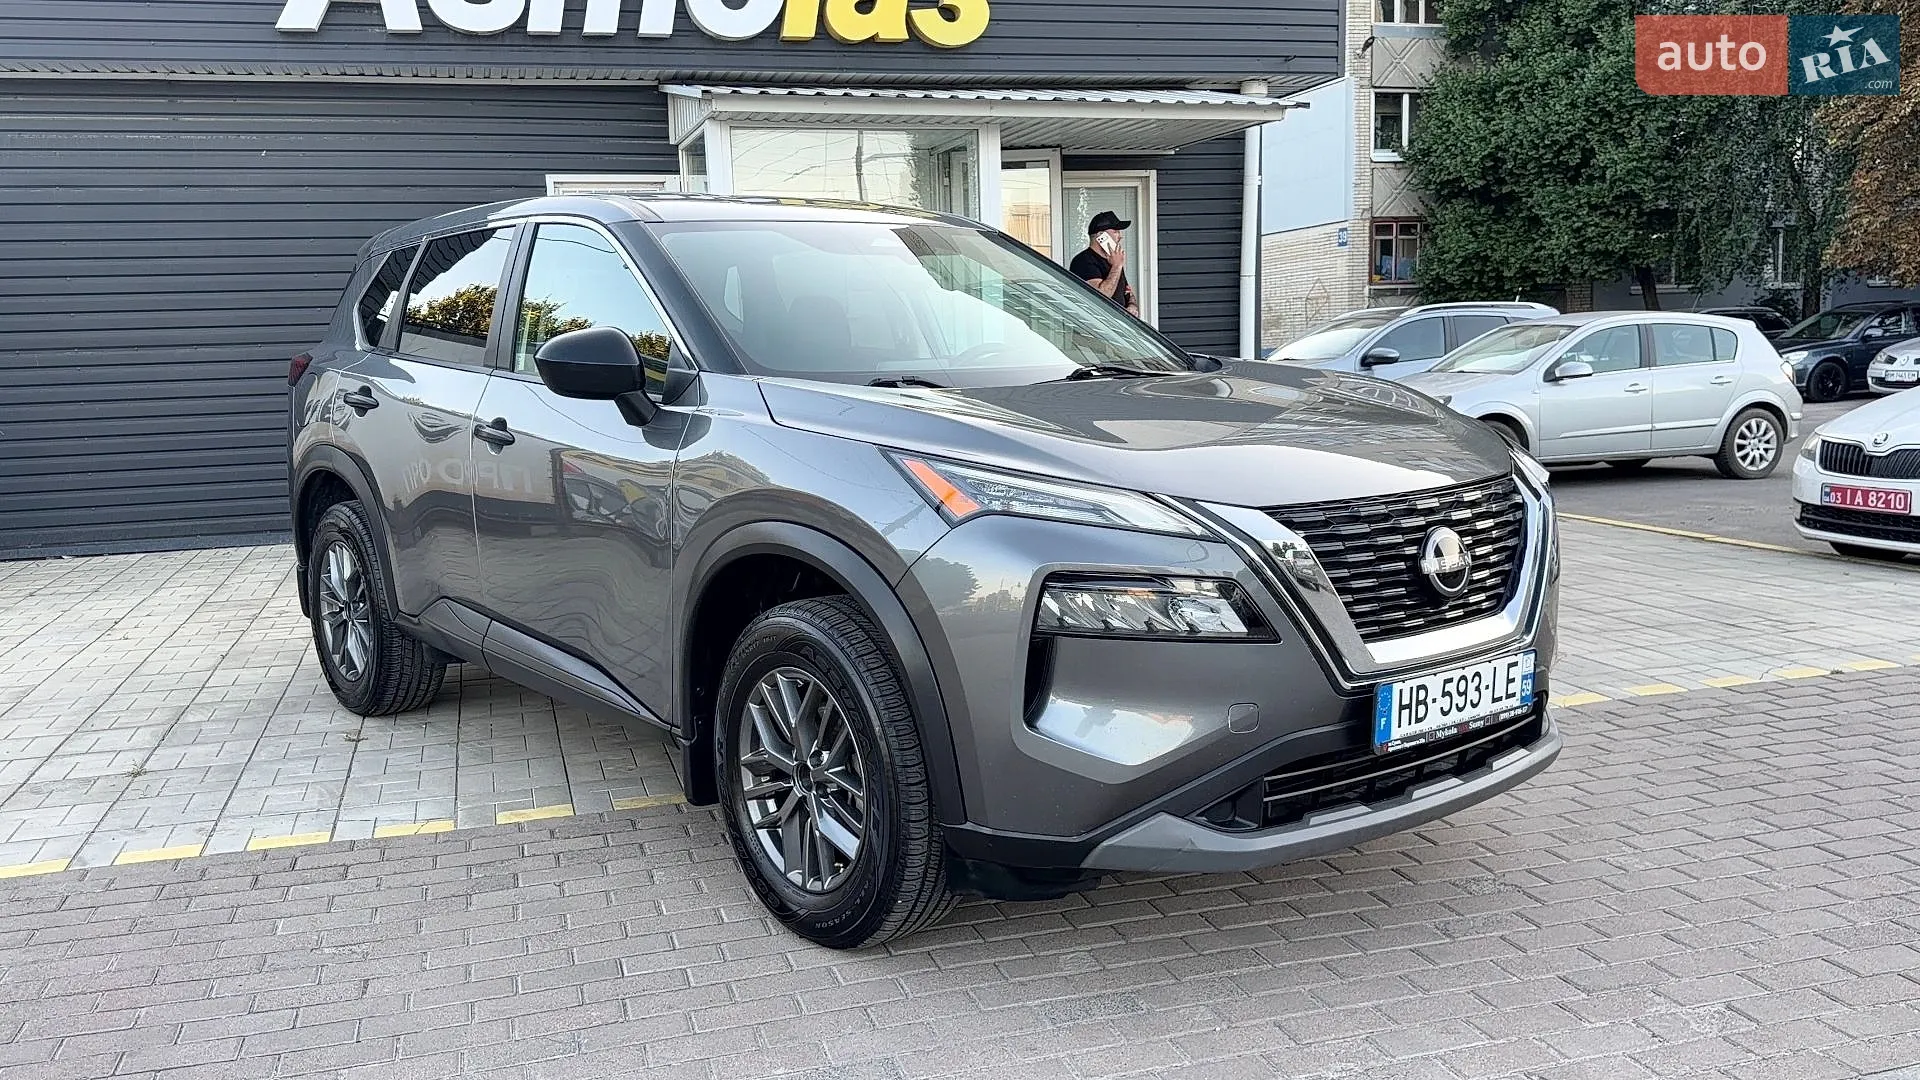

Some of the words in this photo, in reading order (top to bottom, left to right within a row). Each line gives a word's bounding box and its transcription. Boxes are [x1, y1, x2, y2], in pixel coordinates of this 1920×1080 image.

[1338, 231, 1347, 243] 39
[1830, 491, 1842, 504] 03
[1867, 491, 1905, 509] 8210
[1397, 661, 1519, 729] HB-593-LE
[1521, 678, 1532, 697] 59
[1380, 717, 1387, 730] F
[814, 909, 853, 929] SEASON
